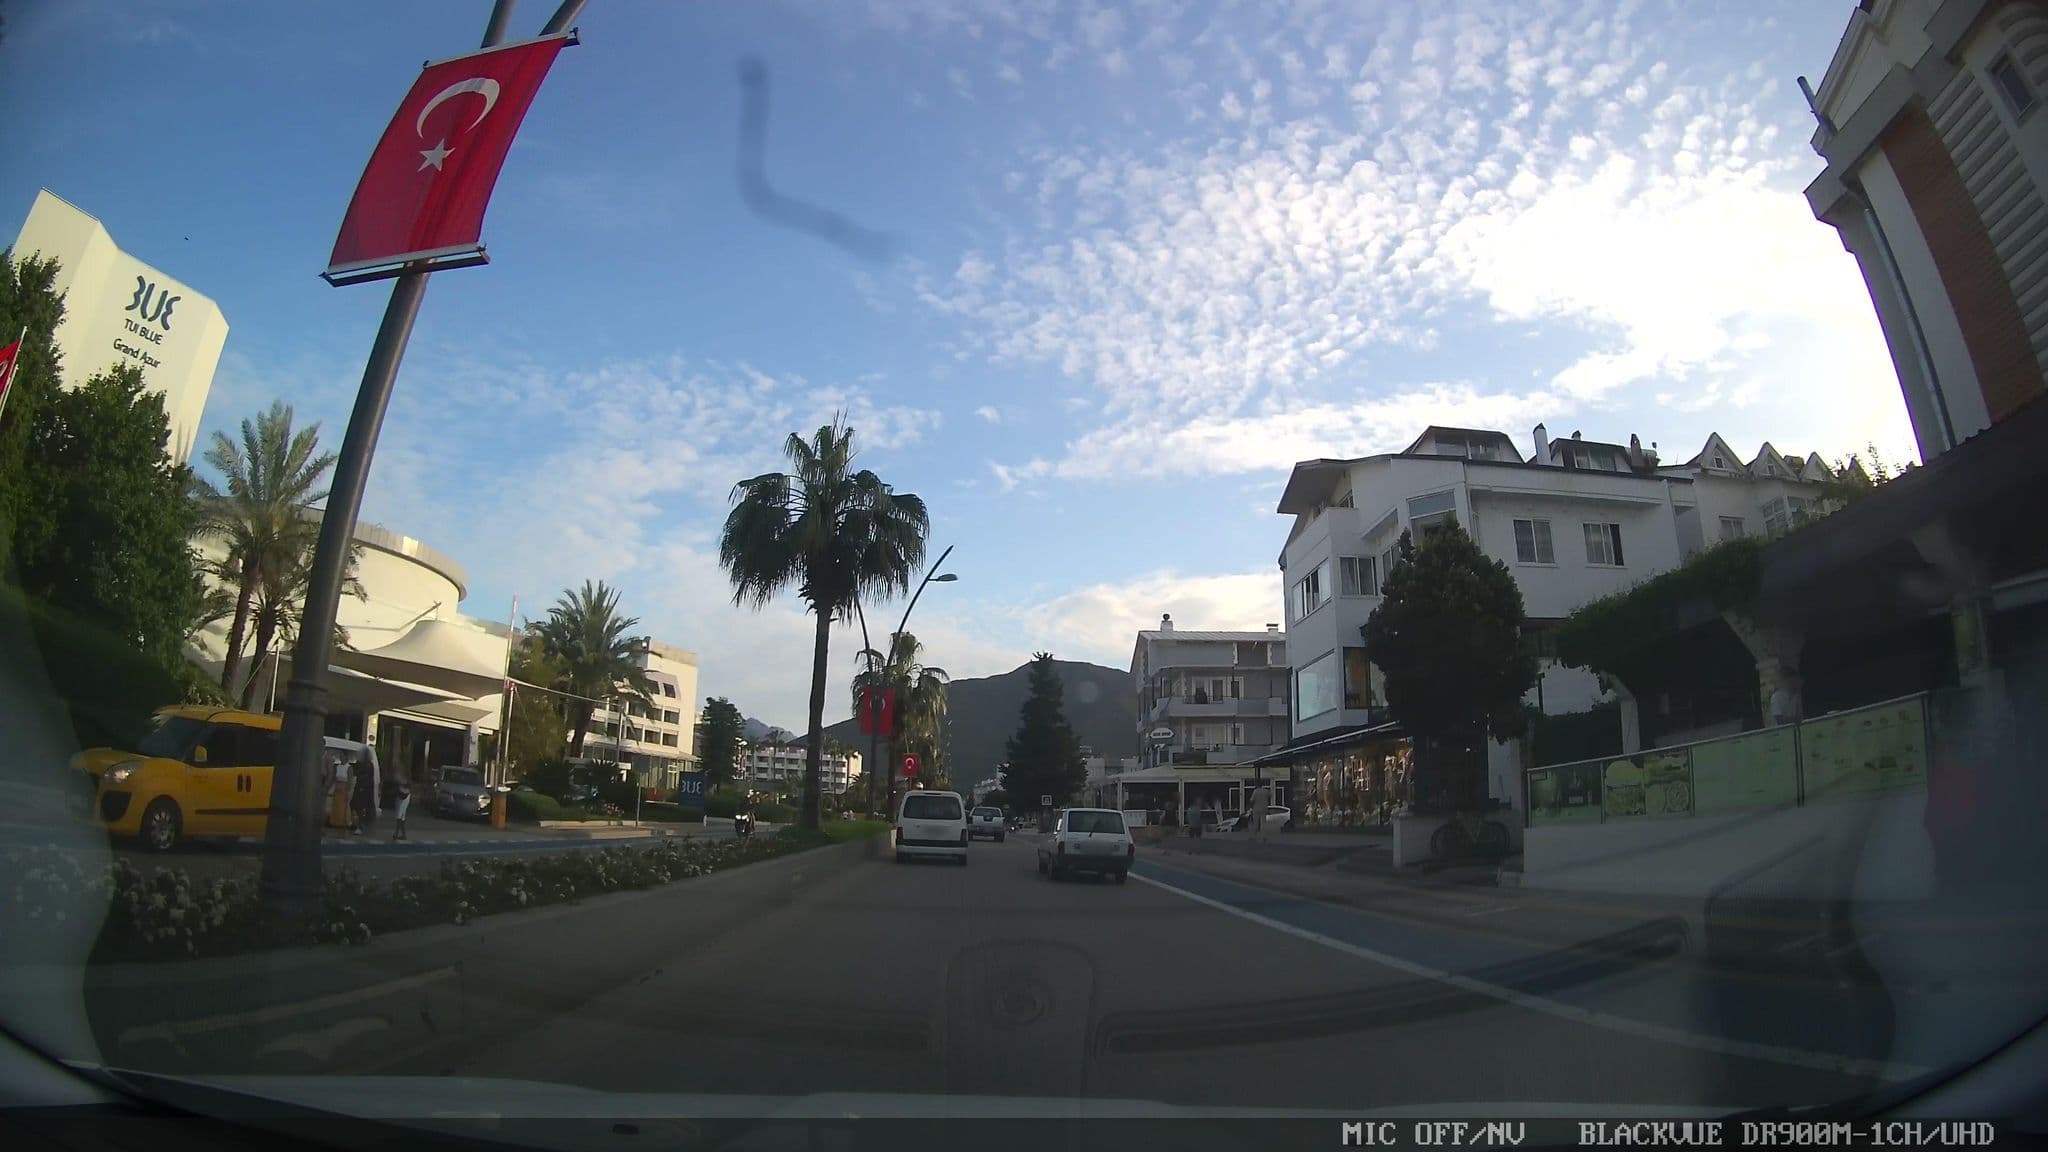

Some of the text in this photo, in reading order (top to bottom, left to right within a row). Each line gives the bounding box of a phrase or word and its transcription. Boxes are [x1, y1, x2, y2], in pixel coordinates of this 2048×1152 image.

[125, 318, 163, 344] TUI BLUE
[113, 338, 160, 368] Grand Azur
